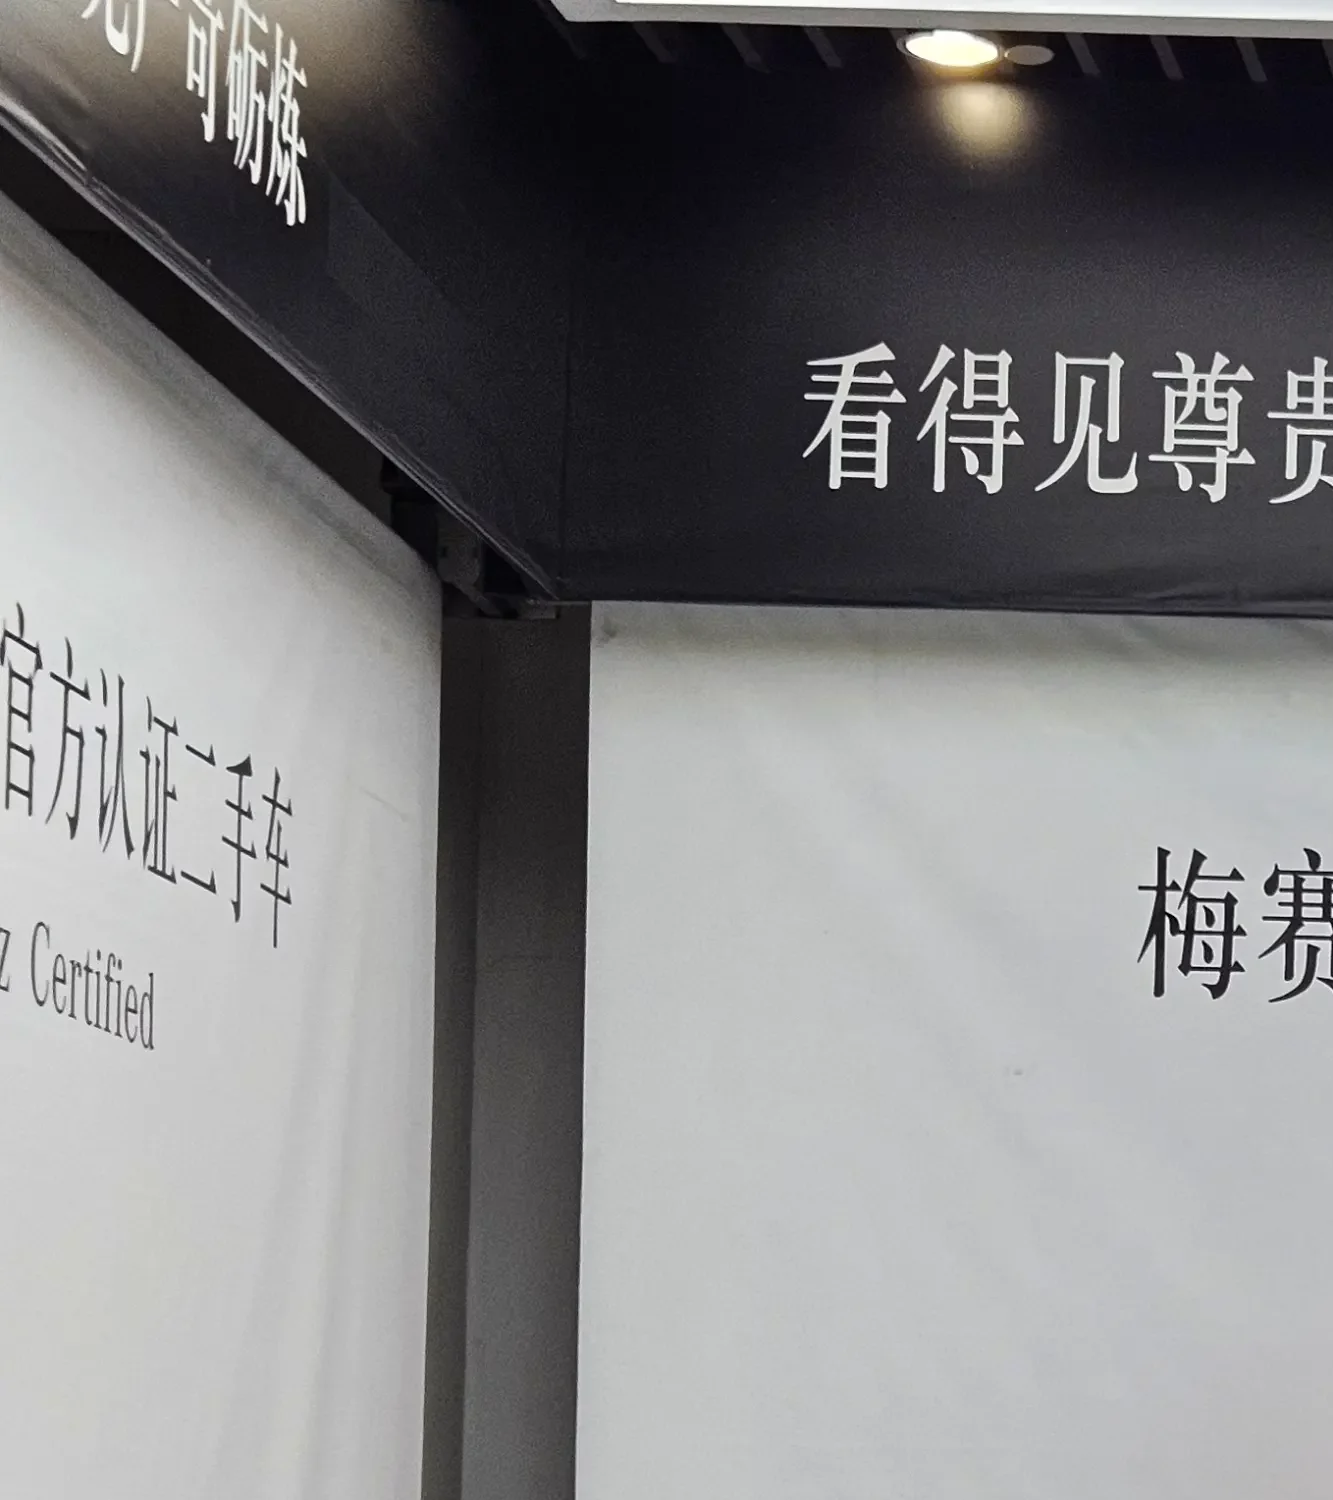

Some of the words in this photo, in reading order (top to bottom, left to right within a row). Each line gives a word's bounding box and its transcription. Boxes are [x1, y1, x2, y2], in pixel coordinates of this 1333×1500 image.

[0, 602, 293, 949] 官方认证二手车
[30, 921, 154, 1051] Certified
